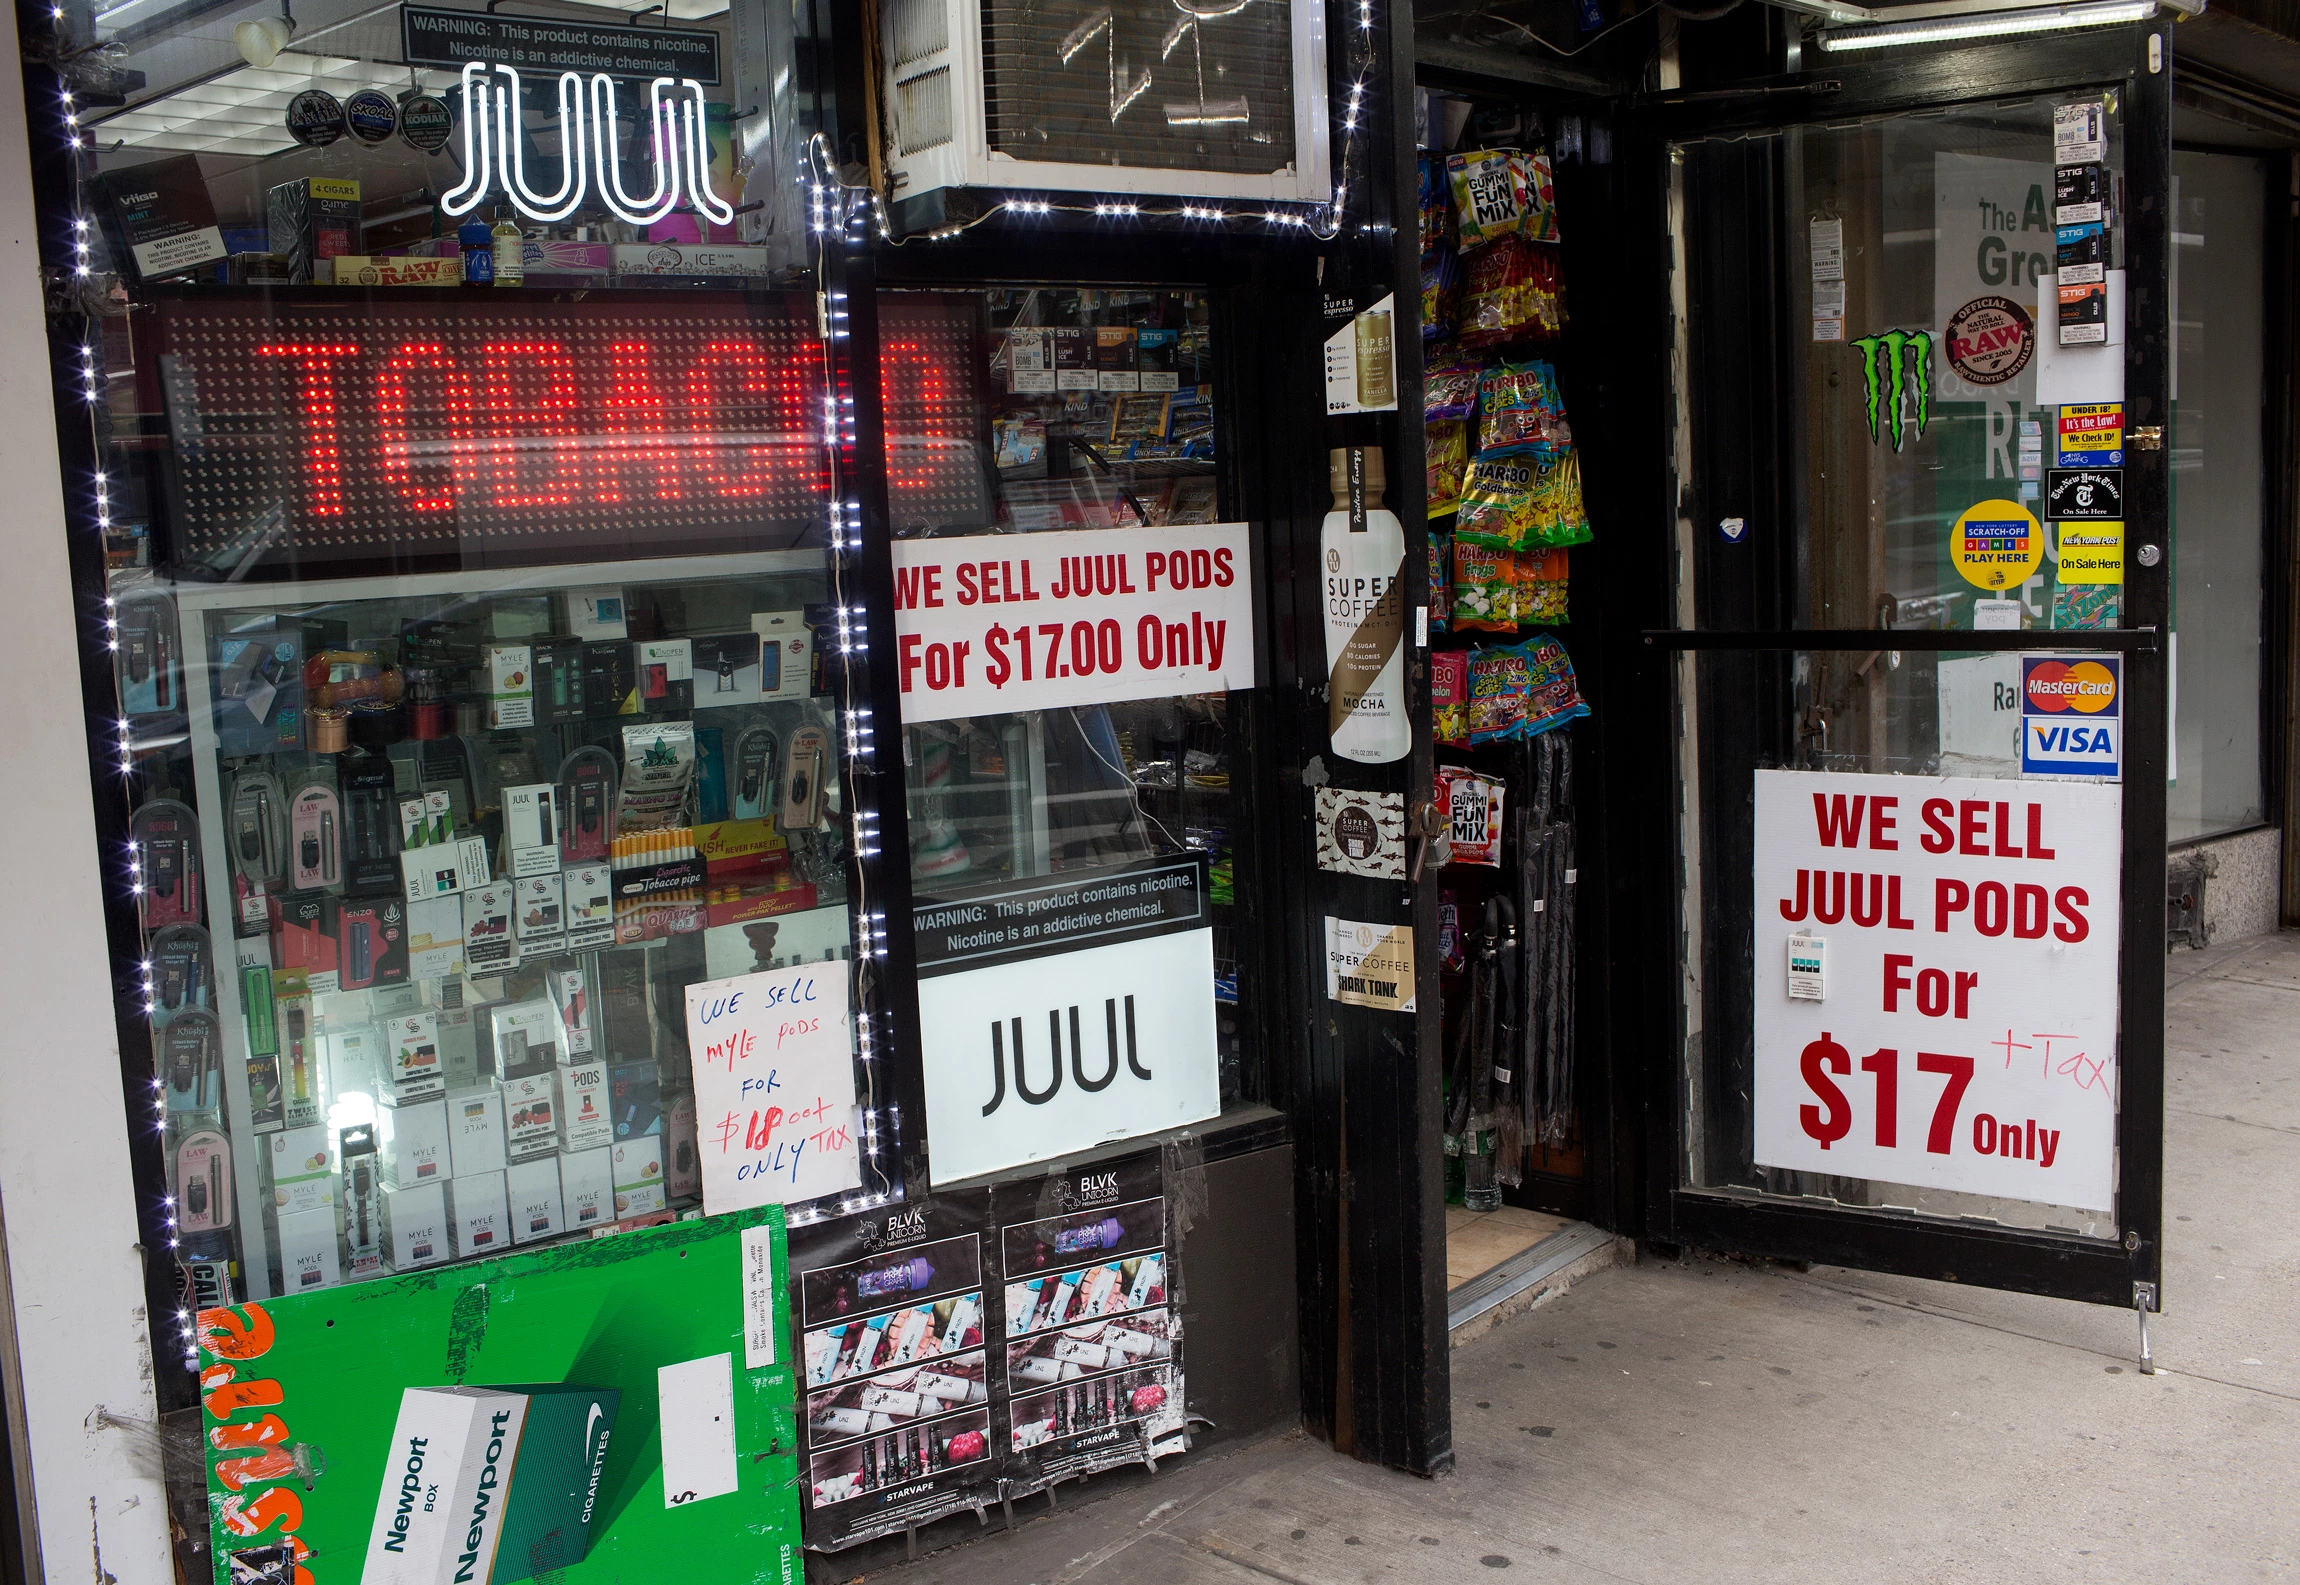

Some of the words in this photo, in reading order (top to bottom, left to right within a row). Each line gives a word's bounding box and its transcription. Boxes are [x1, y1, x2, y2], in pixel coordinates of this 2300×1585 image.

[413, 15, 491, 37] WARNING:
[499, 23, 530, 41] This
[533, 28, 588, 46] product
[592, 34, 650, 49] contains
[653, 39, 711, 54] nicotine.
[450, 41, 509, 60] Nicotine
[513, 45, 525, 60] is
[528, 50, 546, 62] an
[550, 50, 613, 67] addictive
[615, 54, 680, 72] chemical.
[351, 103, 395, 121] SKOAL
[405, 114, 447, 125] KODIAK
[441, 61, 733, 226] JUUL
[2058, 132, 2075, 141] BOMB
[1449, 157, 1464, 168] NEW
[2057, 168, 2083, 178] STIG
[315, 184, 321, 193] 4
[324, 185, 355, 195] CIGARS
[1469, 174, 1510, 190] GUMMI
[321, 200, 349, 213] game
[127, 210, 150, 222] MINT
[1979, 198, 2016, 233] The
[2058, 228, 2083, 238] STIG
[153, 234, 201, 250] WARNING:
[695, 253, 716, 267] ICE
[380, 260, 442, 286] RAW
[1109, 295, 1130, 307] KIND
[2060, 288, 2086, 298] STIG
[1323, 298, 1354, 309] SUPER
[1324, 306, 1354, 316] espresso
[1958, 298, 2008, 320] OFFICIAL
[1967, 315, 2004, 329] NATURAL
[1057, 329, 1080, 338] STIG
[1100, 332, 1122, 340] STIG
[1141, 332, 1162, 341] STIG
[1950, 321, 2025, 361] RAW
[1356, 336, 1390, 348] SUPER
[1972, 353, 1994, 363] SINCE
[1995, 348, 2013, 358] 2005
[2006, 339, 2033, 376] RETAILER
[1954, 360, 2006, 383] RAWTHENTIC
[1482, 371, 1537, 393] HARIBO
[1064, 402, 1088, 412] KIND
[2071, 406, 2097, 414] UNDER
[2100, 405, 2111, 413] 18?
[2066, 418, 2079, 430] It's
[2081, 416, 2095, 428] the
[2097, 414, 2116, 427] Law!
[2068, 434, 2080, 443] We
[2081, 433, 2103, 443] Check
[2104, 433, 2115, 441] ID!
[1473, 462, 1530, 484] HARIBO
[1474, 481, 1525, 496] Goldbears
[2050, 484, 2066, 500] The
[2062, 474, 2081, 488] New
[2080, 472, 2102, 483] York
[2100, 475, 2120, 500] Times
[1968, 527, 2025, 536] SCRATCH-OFF
[2062, 536, 2081, 545] NEW
[2081, 536, 2100, 545] YORK
[2101, 535, 2121, 545] POST
[1964, 554, 1994, 563] PLAY
[1997, 553, 2029, 563] HERE
[2061, 558, 2075, 568] On
[2075, 558, 2097, 569] Sale
[2097, 558, 2121, 569] Here
[1463, 562, 1496, 578] Frogs
[892, 565, 944, 610] WE
[956, 560, 1040, 606] SELL
[1051, 553, 1136, 599] JUUL
[1146, 547, 1235, 592] PODS
[1328, 576, 1398, 597] SUPER
[1329, 598, 1399, 618] COFFEE
[899, 633, 970, 693] For
[984, 617, 1124, 690] $17.00
[1137, 611, 1227, 672] Only
[1473, 656, 1526, 676] HARIBO
[2028, 679, 2113, 696] MasterCard
[1343, 697, 1385, 709] MOCHA
[2030, 726, 2113, 754] VISA
[512, 794, 530, 805] JUUL
[1451, 795, 1487, 806] GUMMI
[1342, 817, 1368, 828] SUPER
[1812, 793, 1899, 851] WE
[1920, 797, 2056, 861] SELL
[725, 845, 748, 855] NEVER
[751, 841, 768, 850] FAKE
[769, 839, 778, 848] IT!
[300, 869, 320, 879] LAW
[641, 878, 680, 892] Tobacco
[681, 874, 701, 888] pipe
[913, 906, 988, 933] WARNING:
[995, 901, 1024, 919] This
[1027, 893, 1080, 917] product
[1082, 885, 1137, 910] contains
[1140, 873, 1193, 894] nicotine.
[1779, 868, 1914, 931] JUUL
[1934, 877, 2090, 944] PODS
[625, 928, 642, 938] HOT
[947, 928, 1005, 951] Nicotine
[1007, 925, 1020, 941] is
[1023, 924, 1040, 938] an
[1043, 911, 1102, 935] addictive
[1105, 900, 1165, 924] chemical.
[1330, 951, 1360, 966] SUPER
[1362, 957, 1410, 972] COFFEE
[1338, 974, 1367, 995] SHARK
[1368, 979, 1399, 999] TANK
[1883, 953, 1978, 1020] For
[701, 991, 745, 1025] WE
[765, 977, 817, 1009] SELL
[982, 994, 1152, 1118] JUUL
[2032, 1033, 2111, 1099] Tax
[741, 1069, 781, 1102] FOR
[1799, 1032, 1975, 1156] $17
[1972, 1112, 2060, 1169] Only
[186, 1148, 208, 1158] LAW
[737, 1138, 807, 1184] ONLY
[1080, 1171, 1118, 1192] BLVK
[1081, 1187, 1119, 1201] UNICORN
[187, 1213, 209, 1223] LAW
[887, 1206, 926, 1232] BLVK
[886, 1223, 927, 1241] UNICORN
[297, 1251, 325, 1266] MYLÉ
[303, 1264, 318, 1272] PODS
[1076, 1430, 1120, 1449] STARVAPE
[581, 1430, 611, 1524] CIGARETTES
[384, 1436, 429, 1553] Newport
[423, 1483, 440, 1514] BOX
[454, 1410, 512, 1585] Newport
[671, 1490, 697, 1505] $
[886, 1482, 934, 1502] STARVAPE
